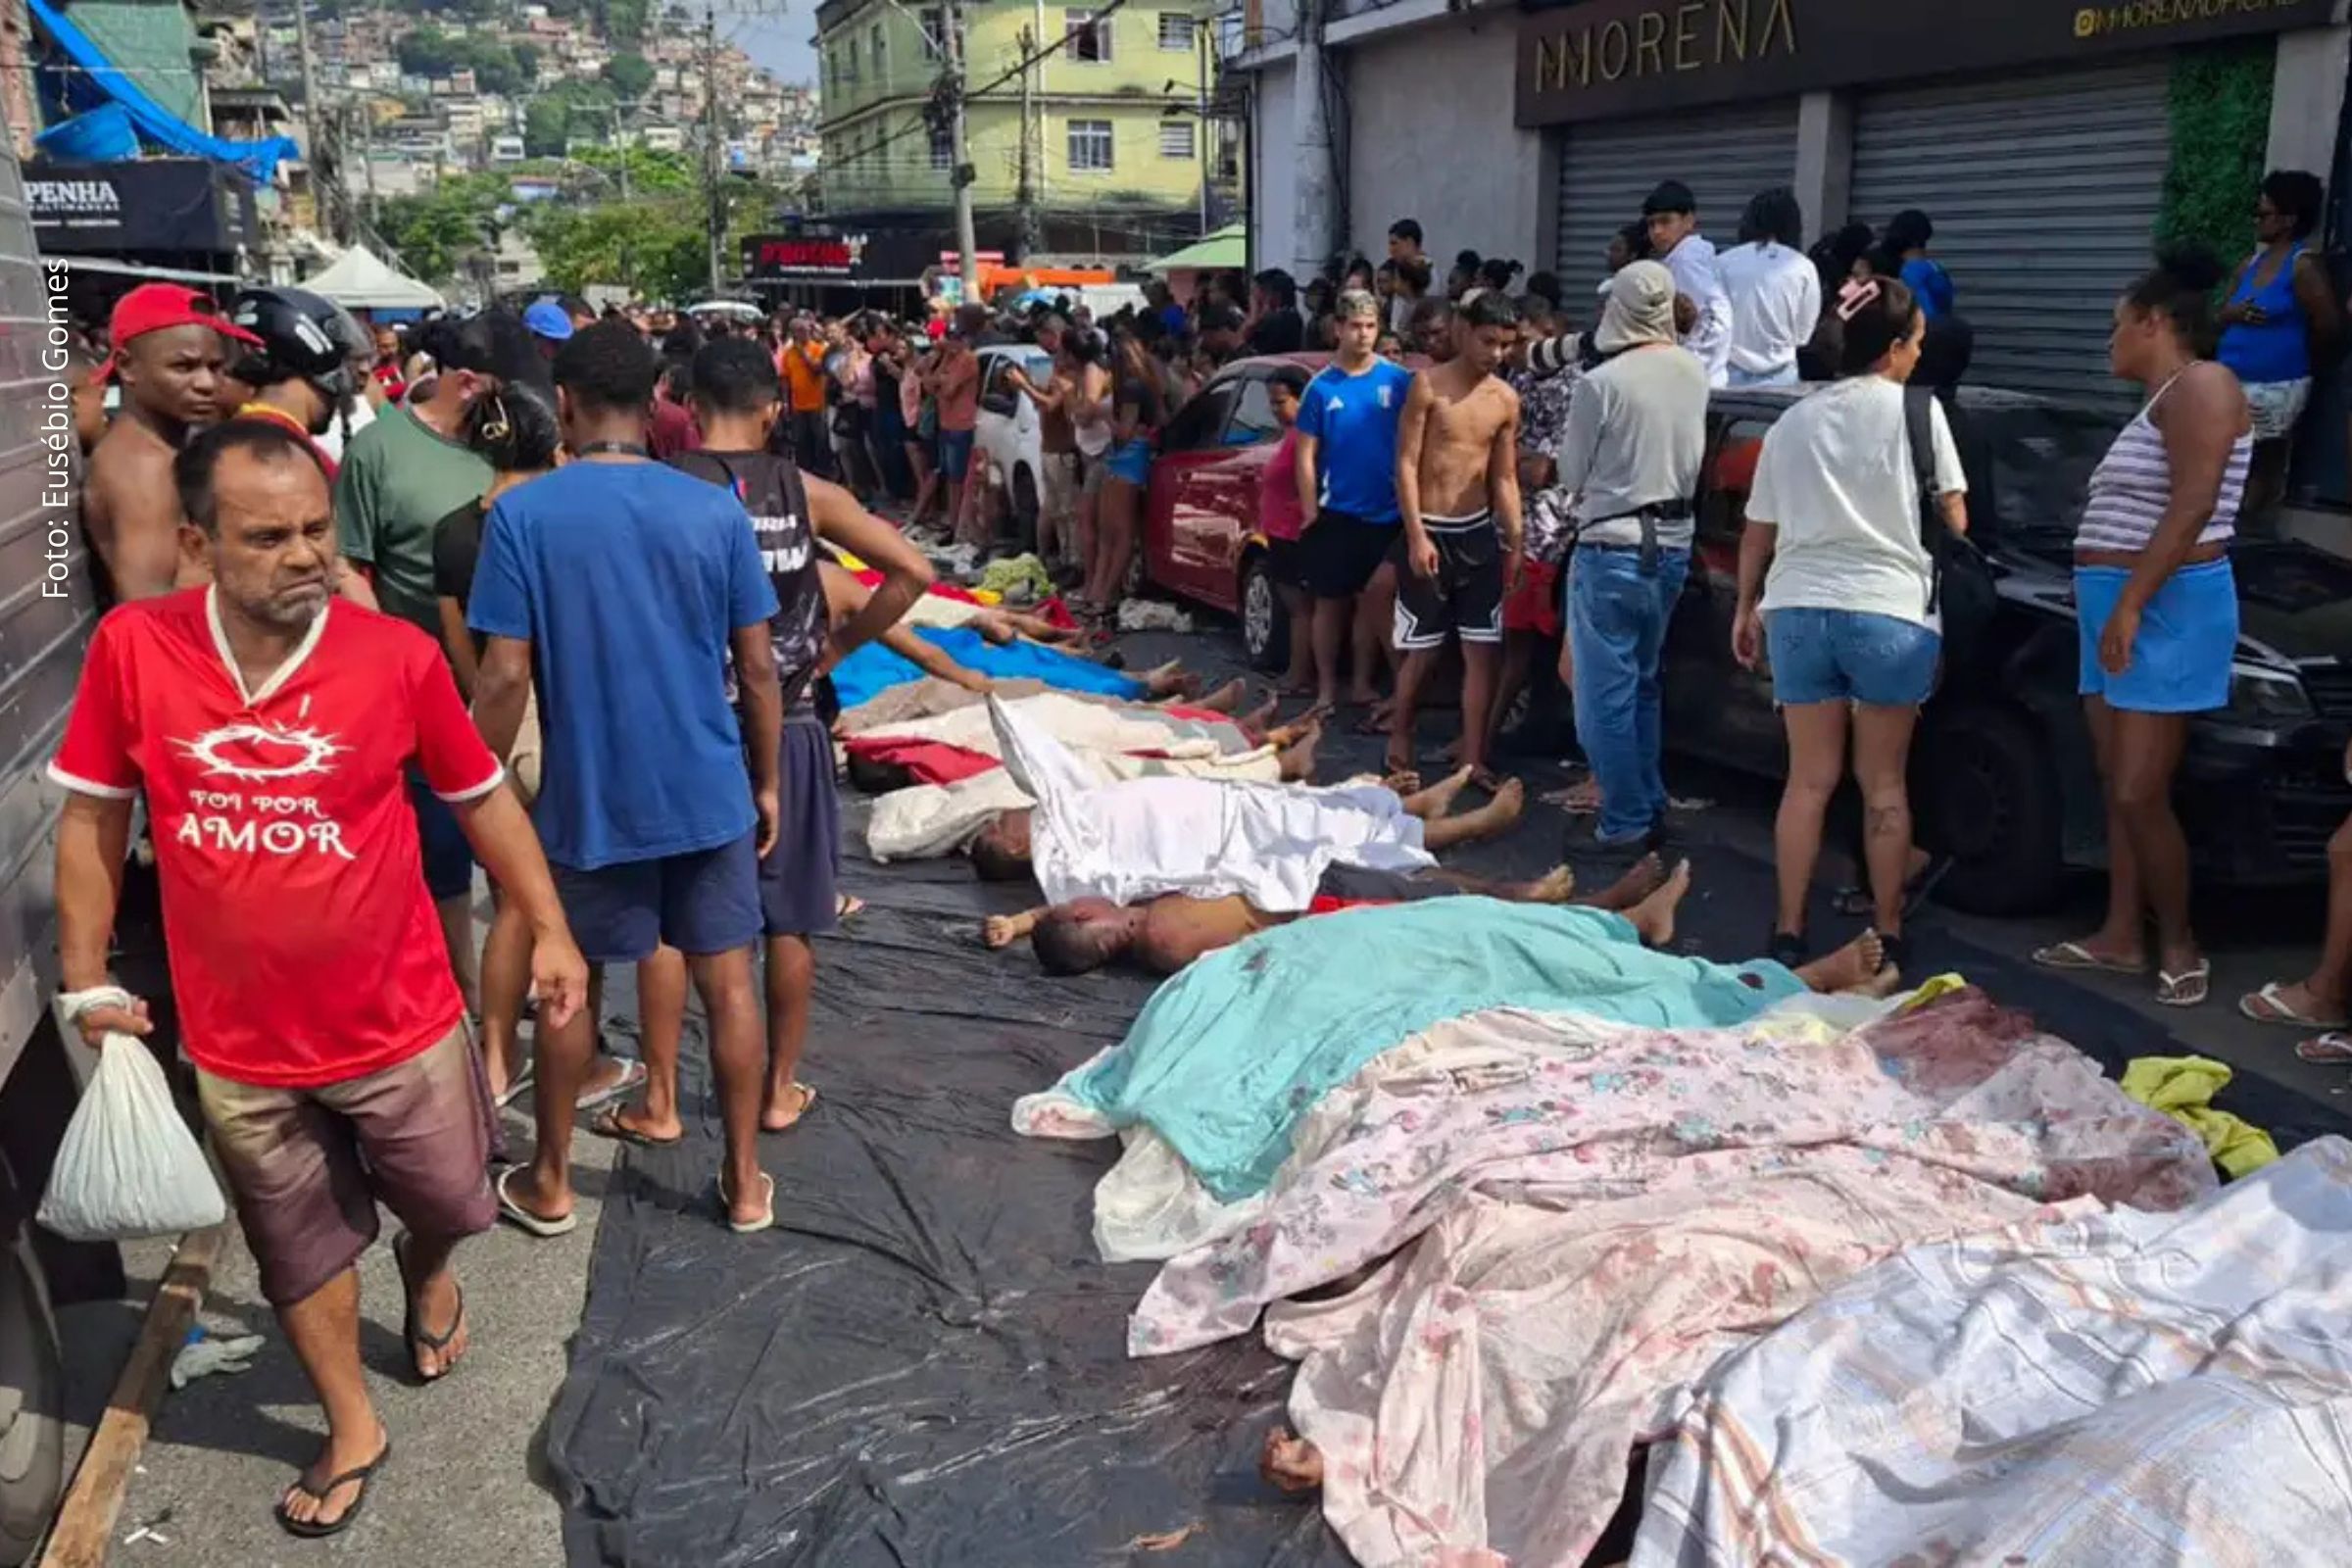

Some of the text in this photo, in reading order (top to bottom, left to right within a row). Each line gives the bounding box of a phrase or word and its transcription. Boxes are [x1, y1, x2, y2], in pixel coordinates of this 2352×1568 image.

[24, 180, 119, 203] PENHA
[189, 790, 329, 819] FOI POR
[176, 812, 357, 859] AMOR
